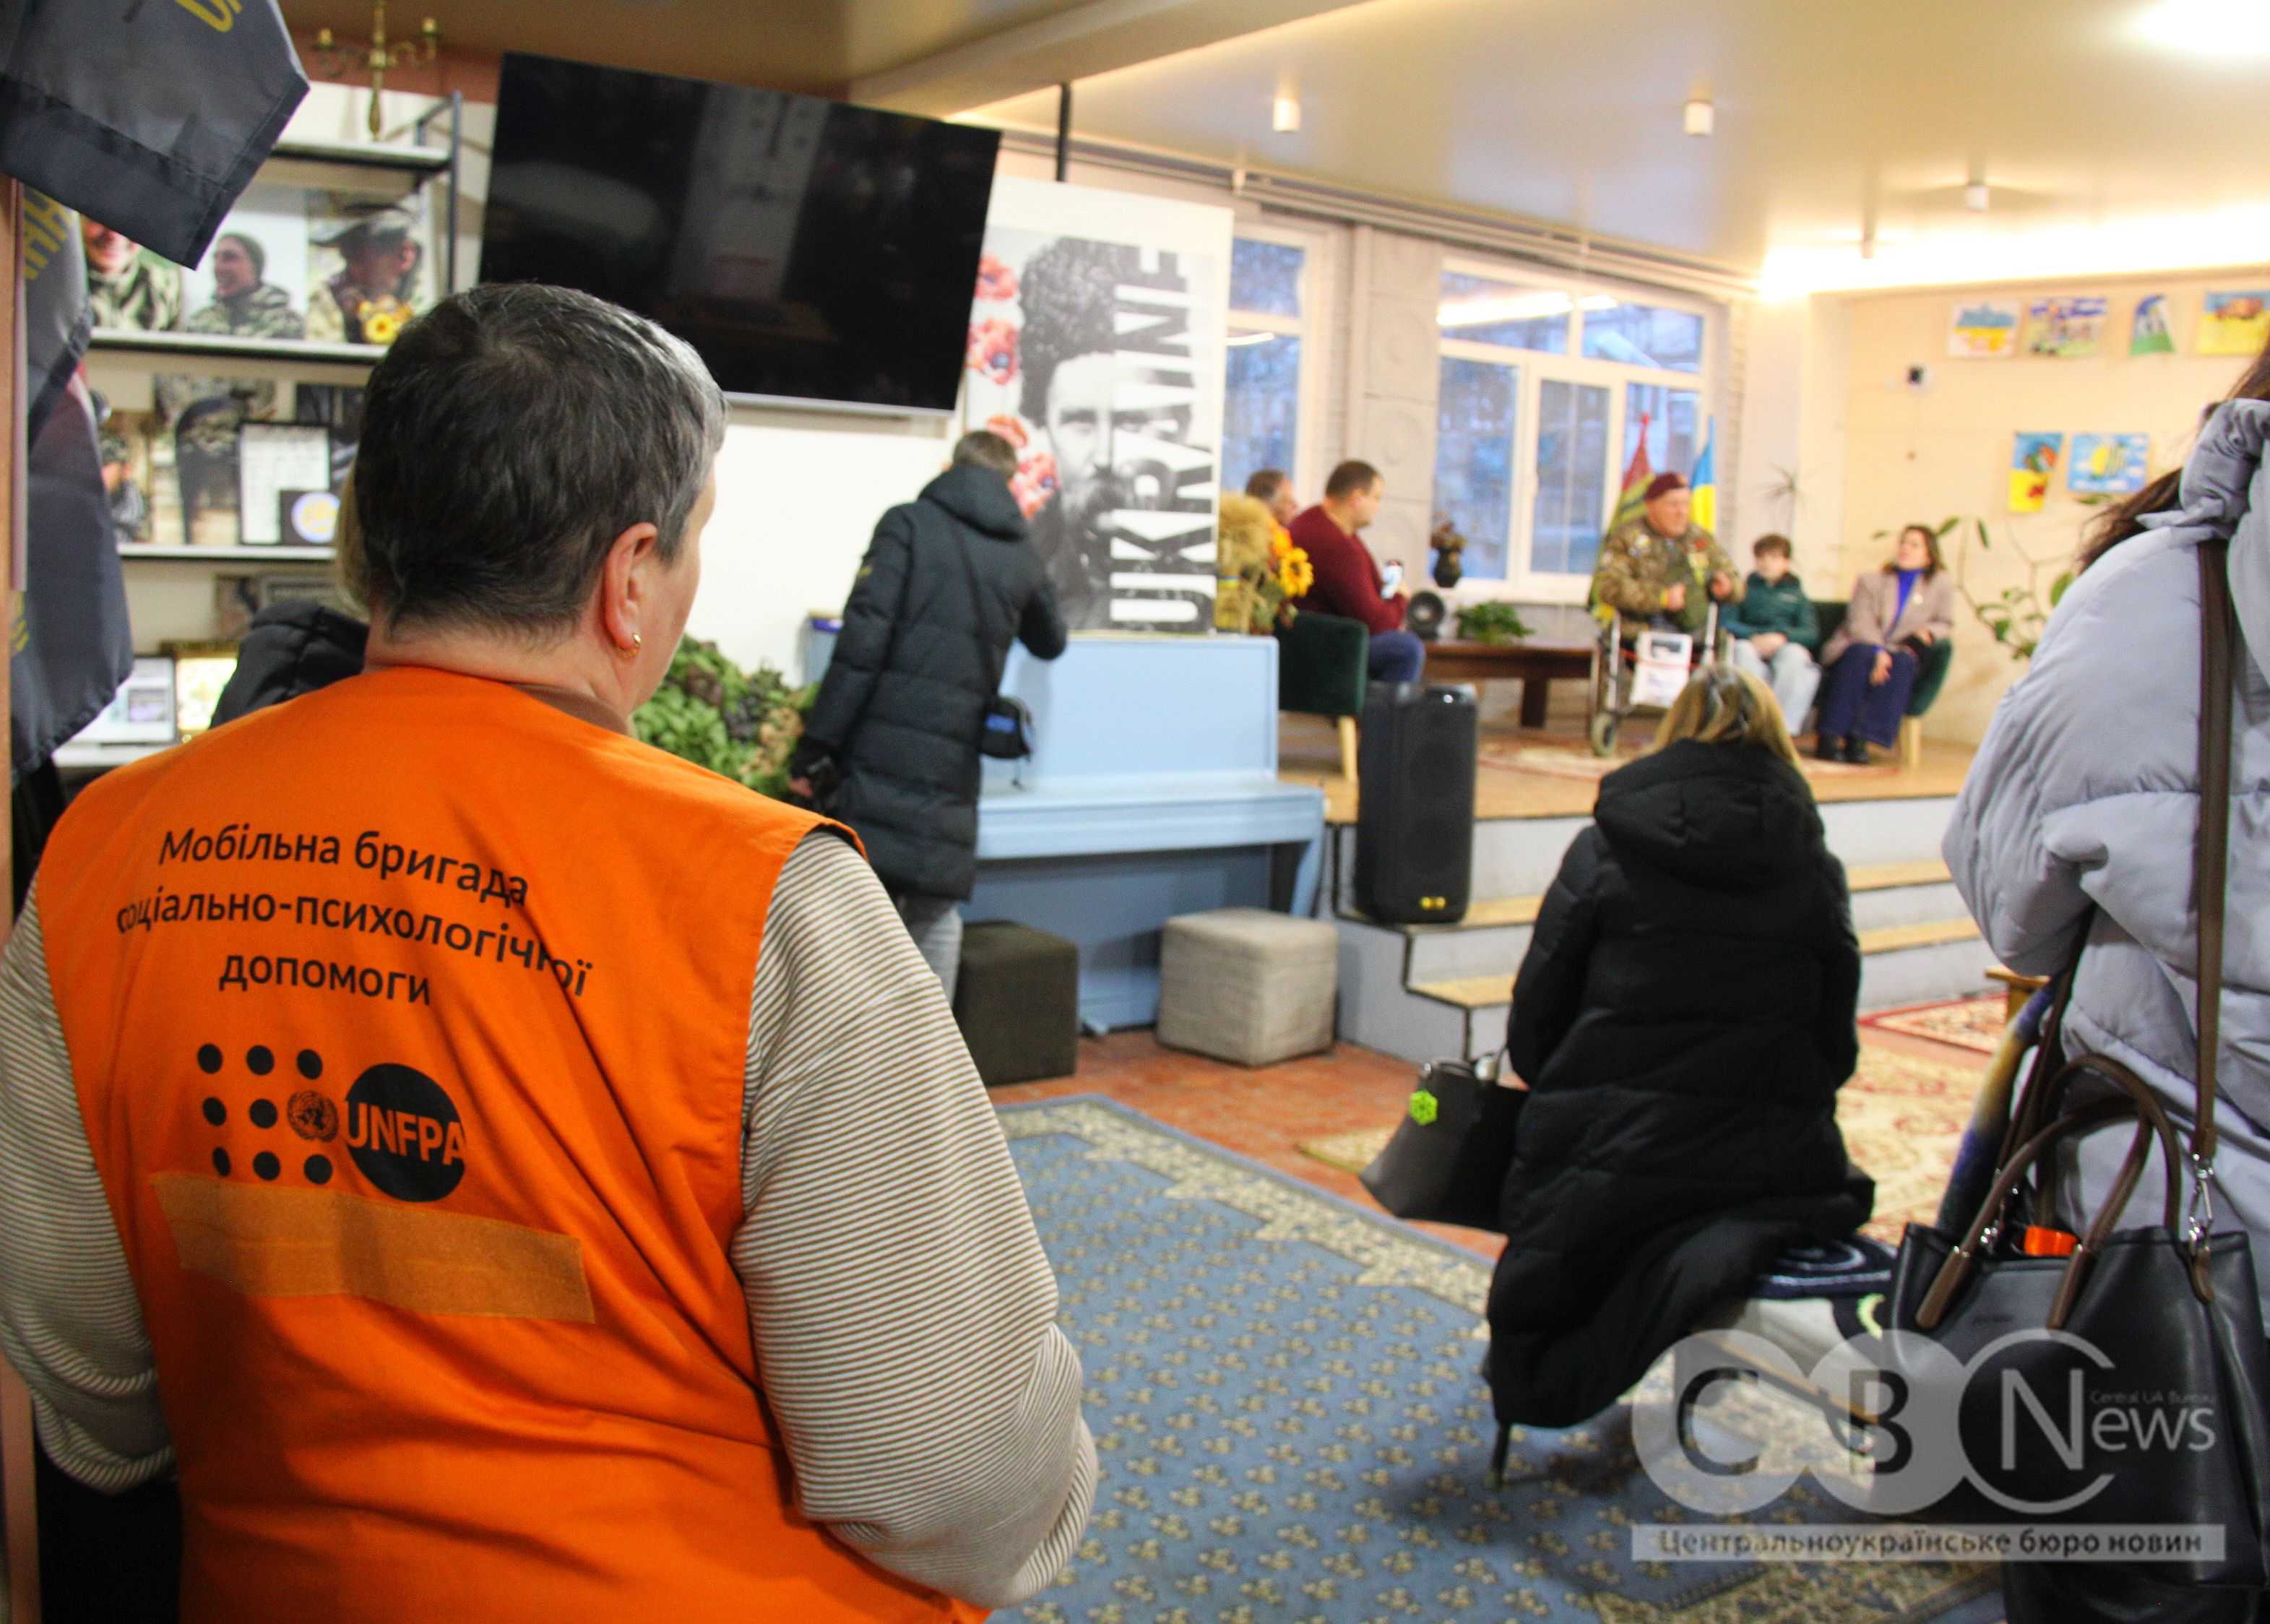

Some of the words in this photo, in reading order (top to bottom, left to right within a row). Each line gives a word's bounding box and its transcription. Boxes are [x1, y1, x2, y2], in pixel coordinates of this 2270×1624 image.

[158, 822, 340, 865] Мобільна
[354, 831, 528, 909] бригада
[218, 954, 431, 1006] допомоги
[345, 1100, 466, 1166] UNFPA
